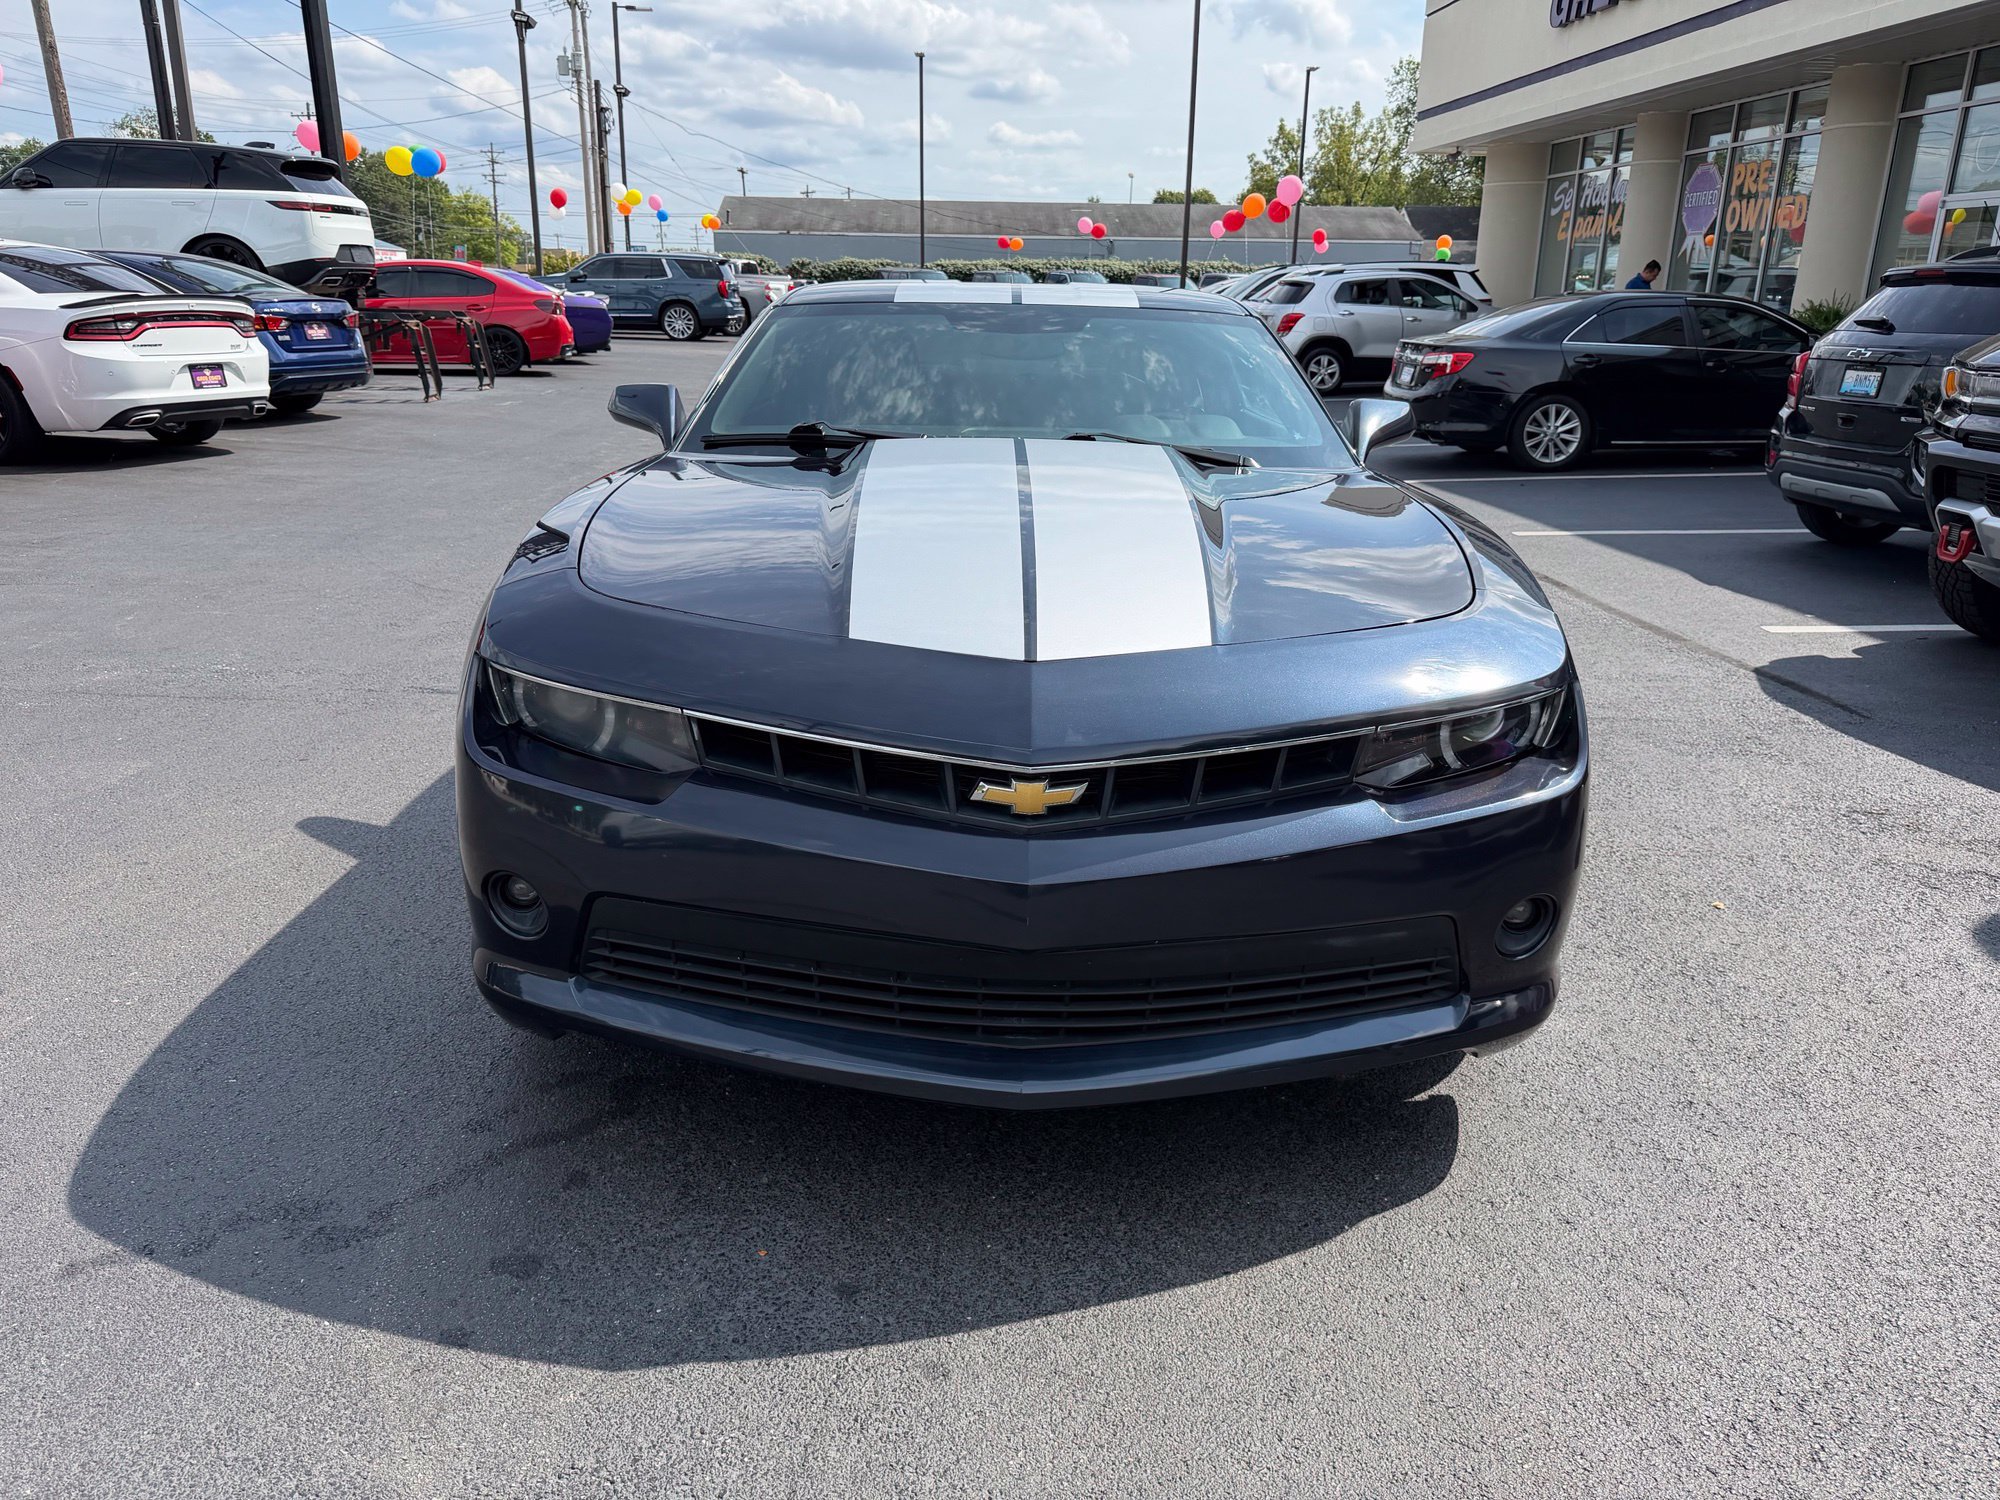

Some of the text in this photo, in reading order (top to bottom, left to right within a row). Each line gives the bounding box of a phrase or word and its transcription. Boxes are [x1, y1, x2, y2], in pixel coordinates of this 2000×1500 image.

[1550, 181, 1574, 216] Se
[1684, 190, 1718, 208] CERTIFIED
[1557, 203, 1623, 249] Epañol
